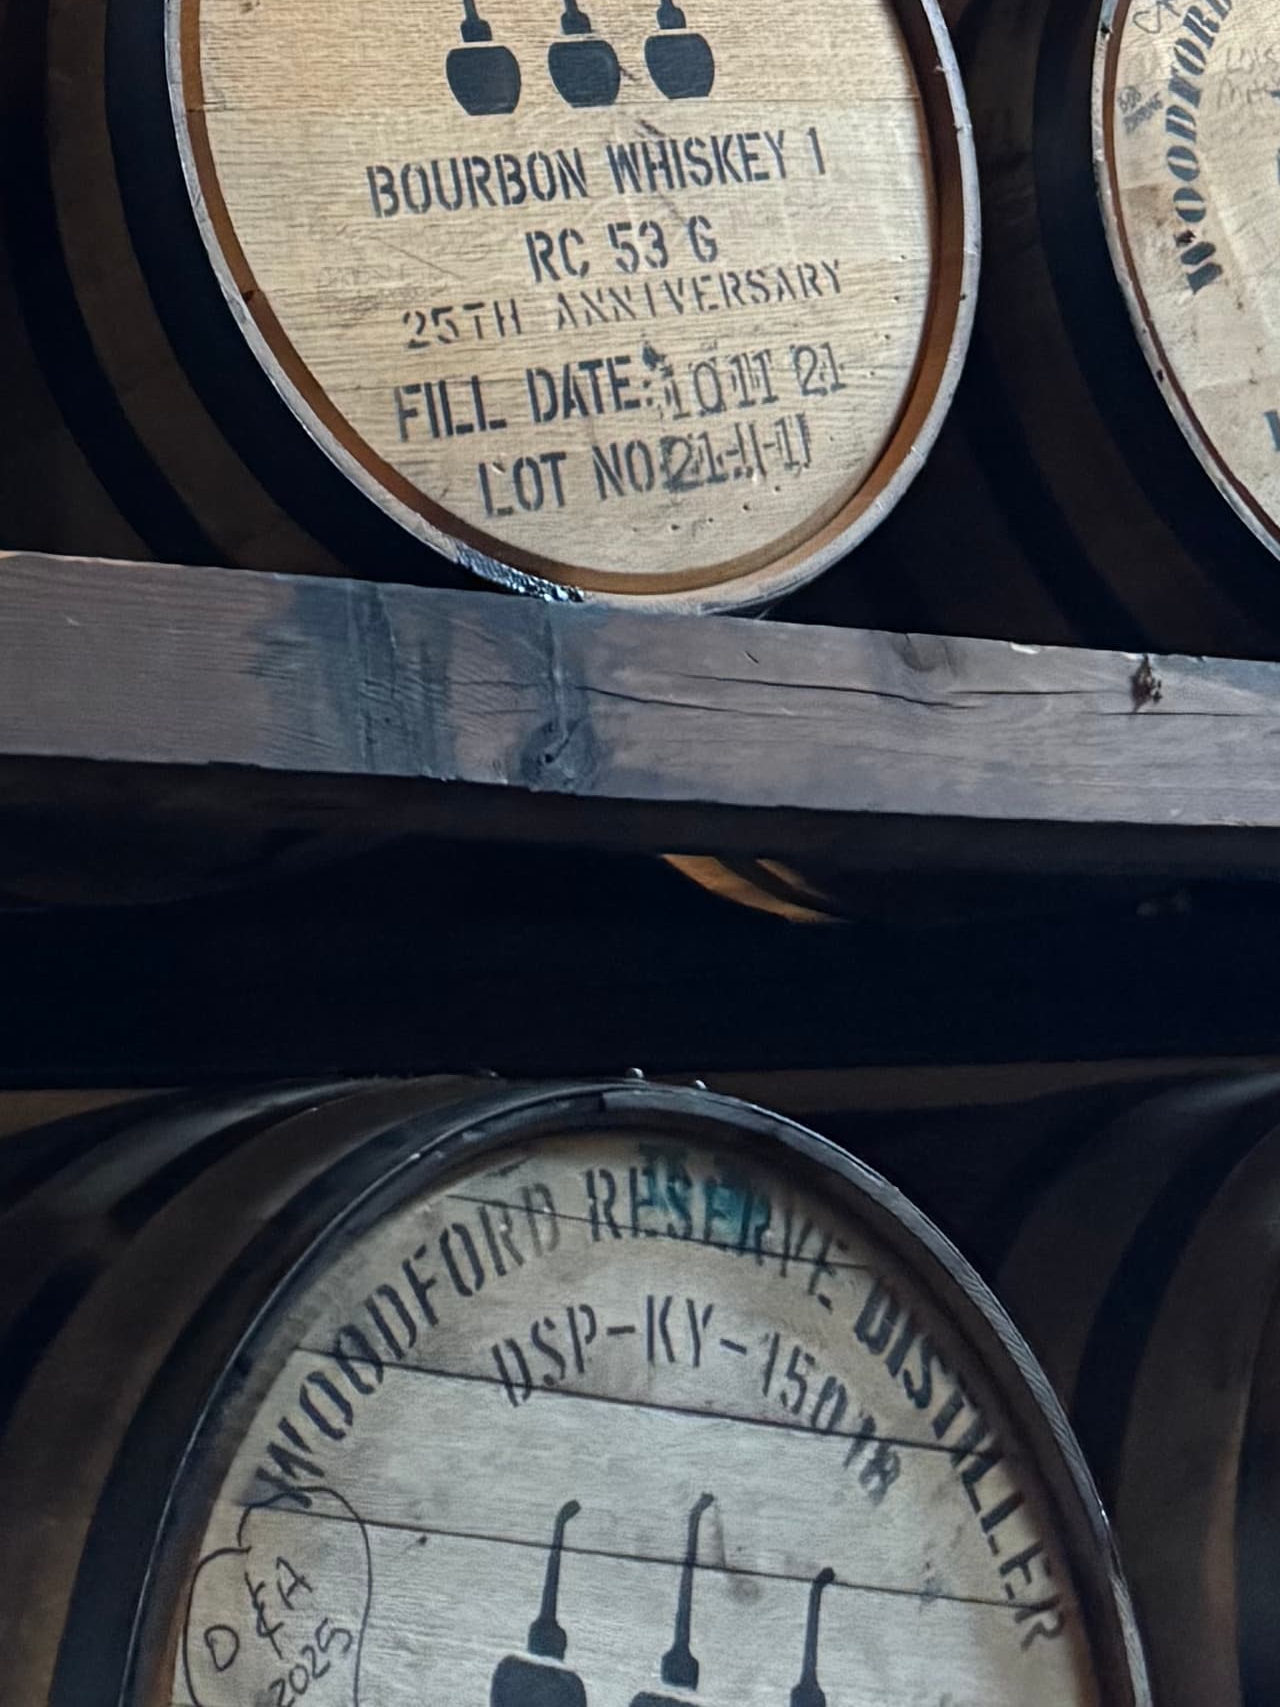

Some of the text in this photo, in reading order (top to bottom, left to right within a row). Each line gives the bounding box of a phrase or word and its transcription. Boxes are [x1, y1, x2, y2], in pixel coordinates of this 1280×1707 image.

[366, 127, 826, 218] BOURBON WHISKEY 1
[525, 229, 589, 283] RC
[608, 220, 668, 274] 53
[403, 260, 842, 349] 25TH ANNIVERSARY
[394, 377, 507, 442] FILL
[478, 452, 568, 517] LOT
[593, 440, 656, 501] NO
[251, 1182, 563, 1510] WOODFORD
[584, 1165, 848, 1313] RESERVE
[491, 1293, 900, 1504] DSP-KY-15018
[268, 1617, 353, 1707] 2025
